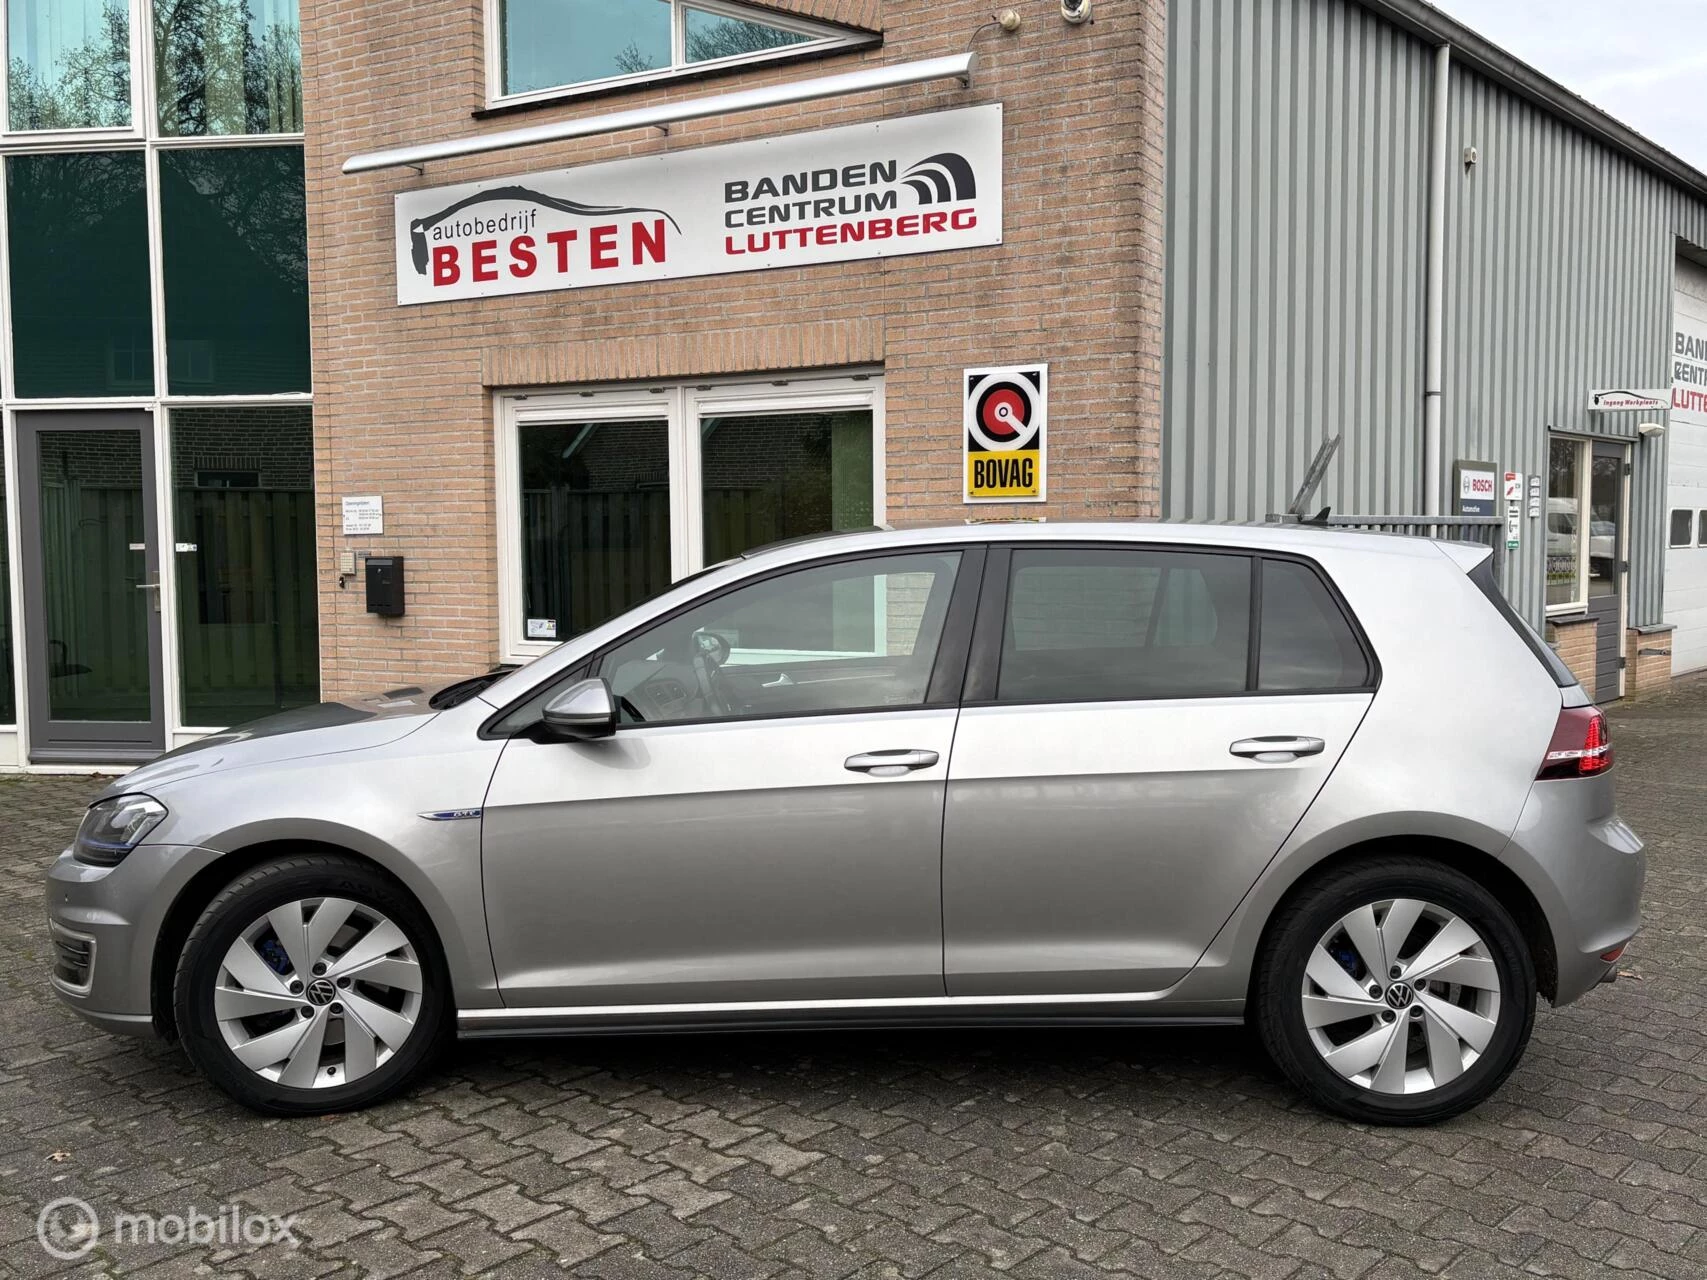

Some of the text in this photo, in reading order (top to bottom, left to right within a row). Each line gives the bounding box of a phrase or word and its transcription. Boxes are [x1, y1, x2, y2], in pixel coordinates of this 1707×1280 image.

[724, 159, 897, 203] BANDEN
[432, 209, 537, 240] autobedrijf
[724, 190, 897, 229] CENTRUM
[725, 208, 977, 255] LUTTENBERG
[432, 219, 666, 287] BESTEN
[1603, 399, 1659, 407] Ingang Werkplaats
[974, 458, 1033, 488] BOVAG
[1472, 479, 1493, 493] BOSCH
